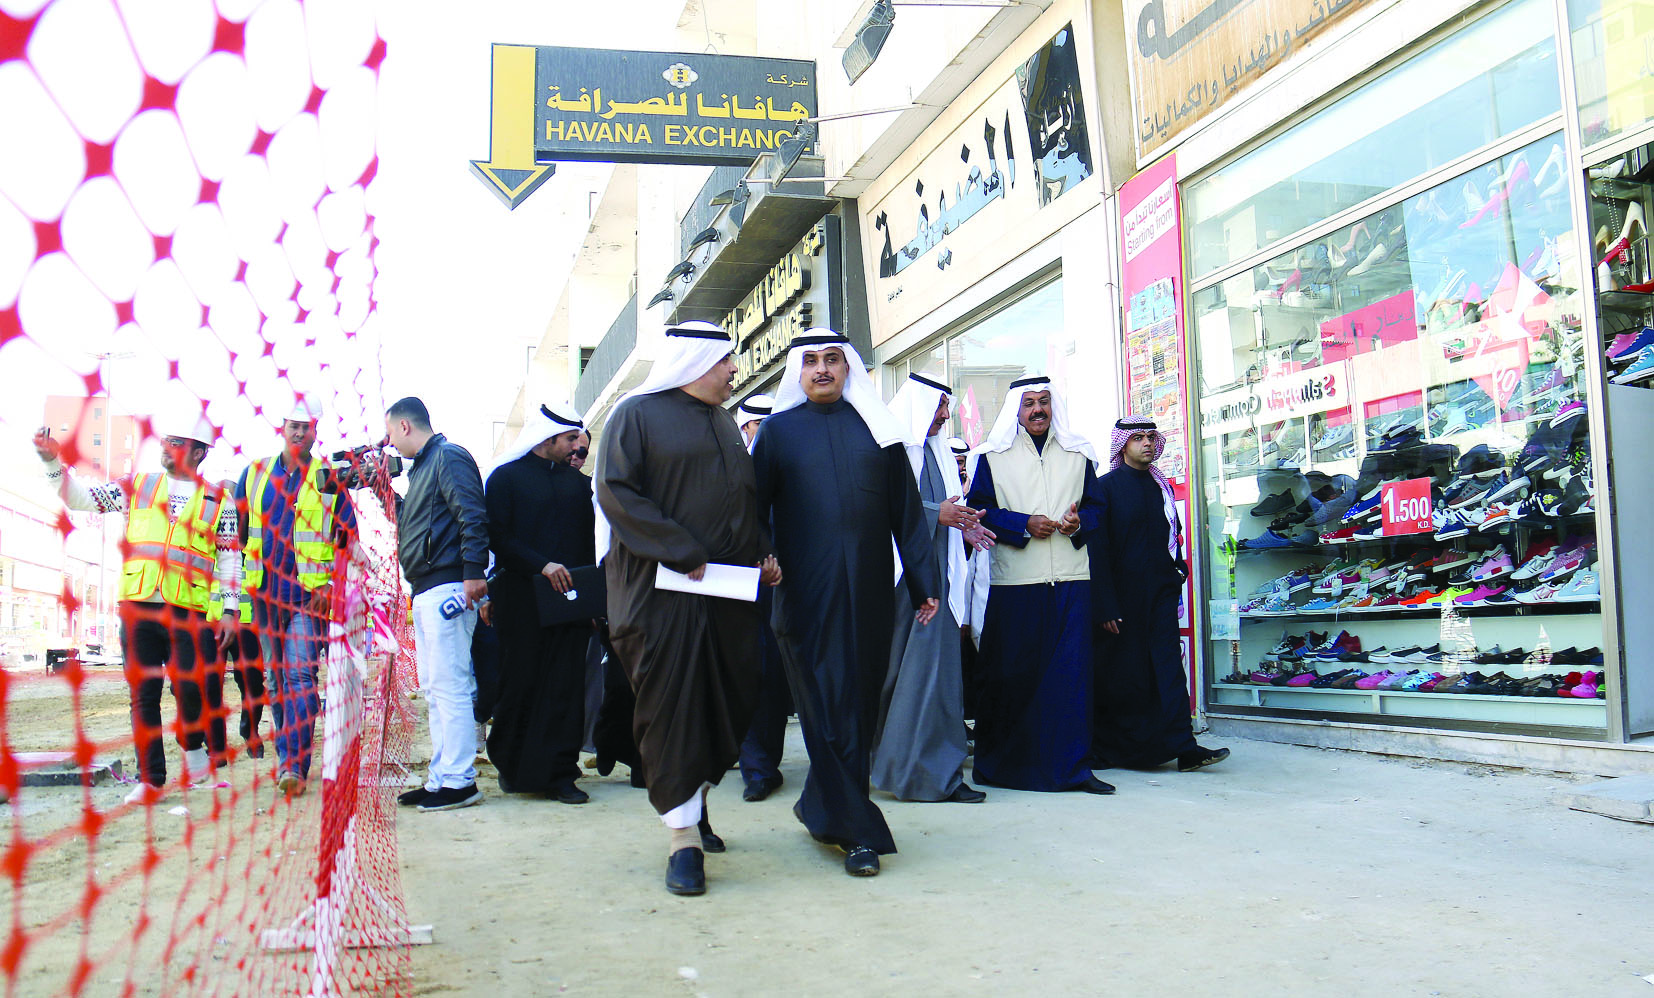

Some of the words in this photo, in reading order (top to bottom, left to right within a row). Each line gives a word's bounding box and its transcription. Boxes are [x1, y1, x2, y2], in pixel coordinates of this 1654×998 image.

[766, 73, 809, 87] شركة
[546, 85, 688, 120] للصرافة
[697, 92, 809, 122] هافانا
[1141, 79, 1220, 142] والكماليات
[545, 120, 653, 145] HAVANA
[664, 125, 810, 151] EXCHANG
[1127, 224, 1155, 255] Starting
[1156, 207, 1173, 231] from
[753, 303, 811, 372] EXCHANGE
[1383, 488, 1429, 523] 1.500
